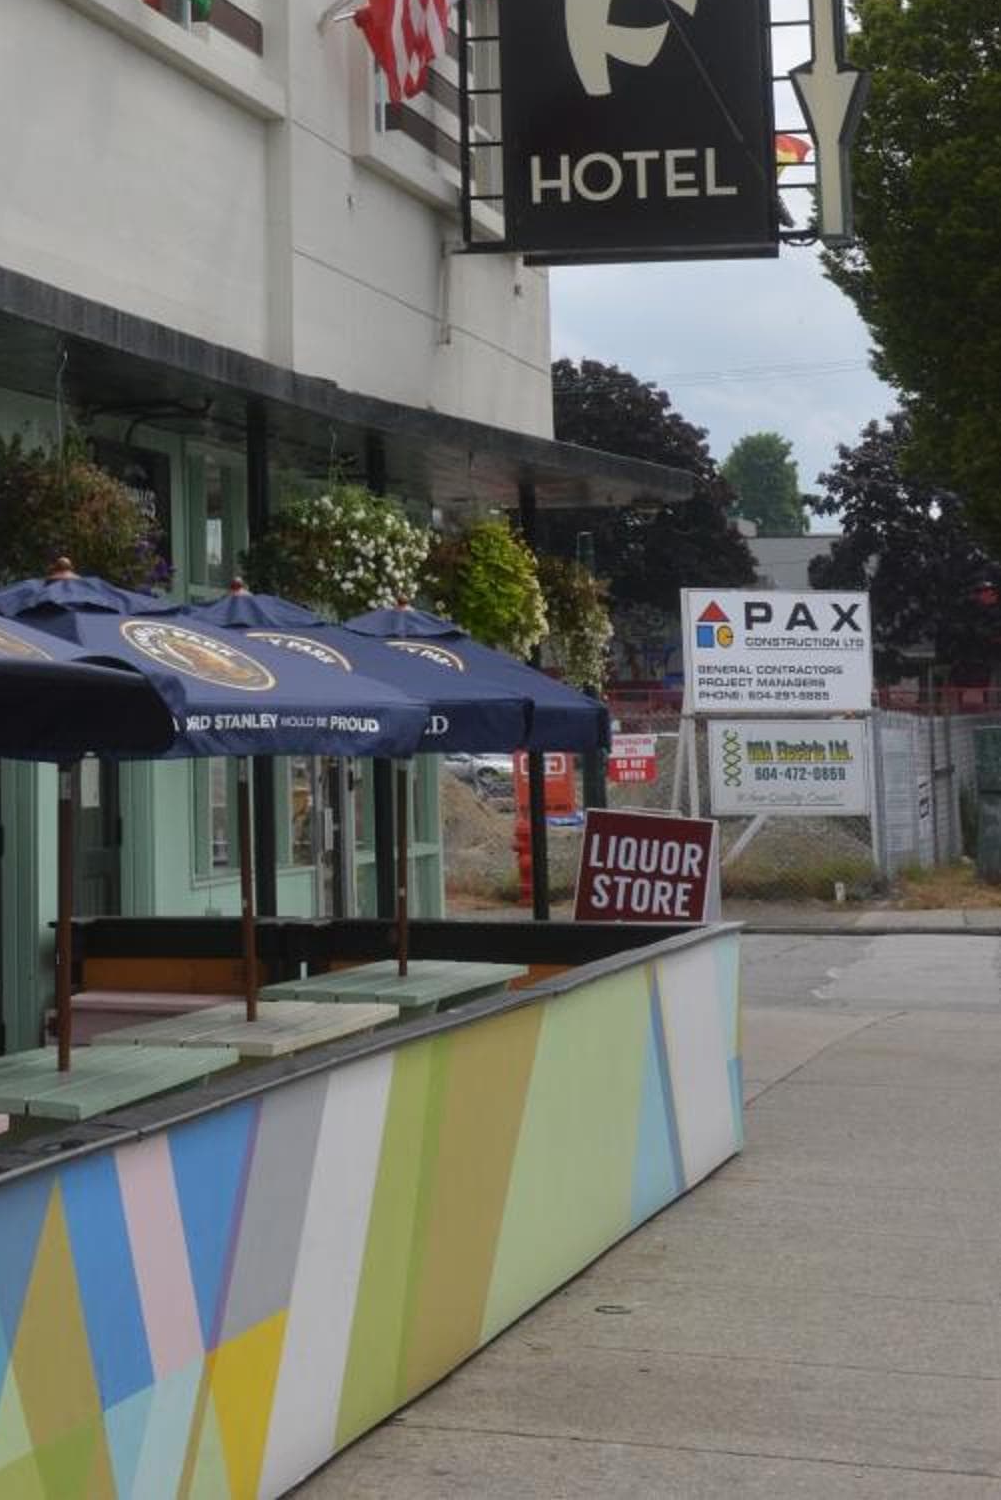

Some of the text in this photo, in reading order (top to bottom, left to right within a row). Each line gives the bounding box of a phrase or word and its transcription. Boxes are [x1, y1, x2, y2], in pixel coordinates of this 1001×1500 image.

[530, 147, 738, 203] HOTEL
[744, 601, 862, 632] PAX
[745, 637, 840, 647] CONSTRUCTION
[698, 665, 844, 675] GENERAL CONTRACTORS
[698, 678, 826, 688] PROJECT MANAGERS
[214, 713, 279, 730] STANLEY
[330, 715, 380, 733] PROUD
[589, 833, 703, 877] LIQUOR
[591, 874, 692, 917] STORE
